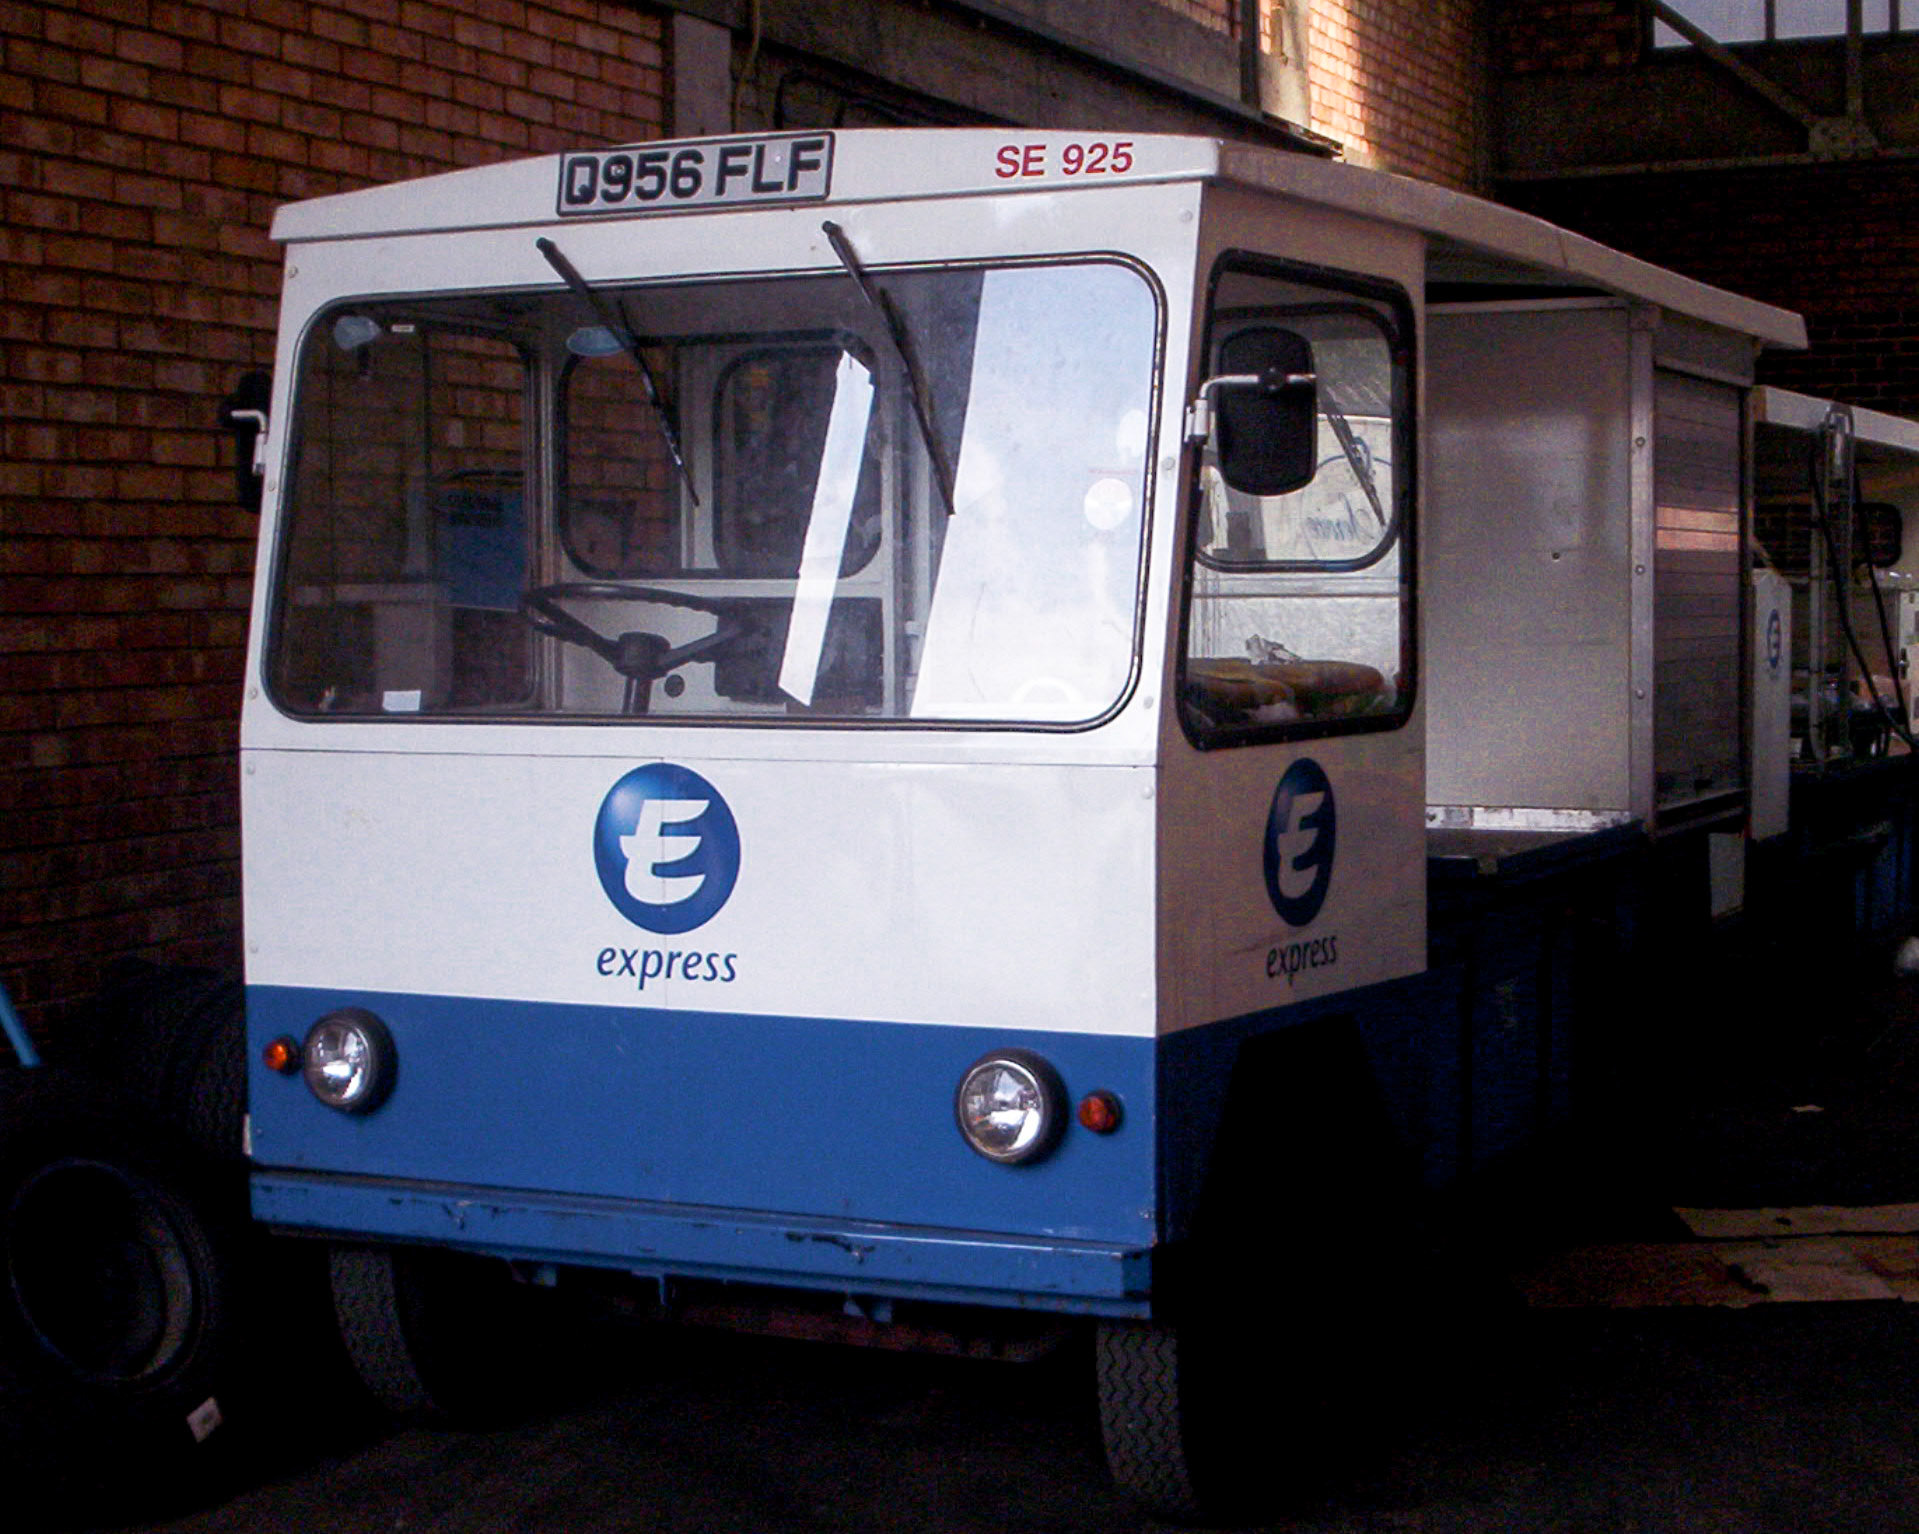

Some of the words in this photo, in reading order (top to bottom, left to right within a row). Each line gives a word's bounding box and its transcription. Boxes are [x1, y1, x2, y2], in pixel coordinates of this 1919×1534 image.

[565, 149, 704, 205] Q956
[715, 139, 825, 196] FLF
[995, 144, 1046, 178] SE
[1062, 142, 1133, 175] 925
[597, 947, 737, 990] express
[1266, 936, 1337, 986] express
